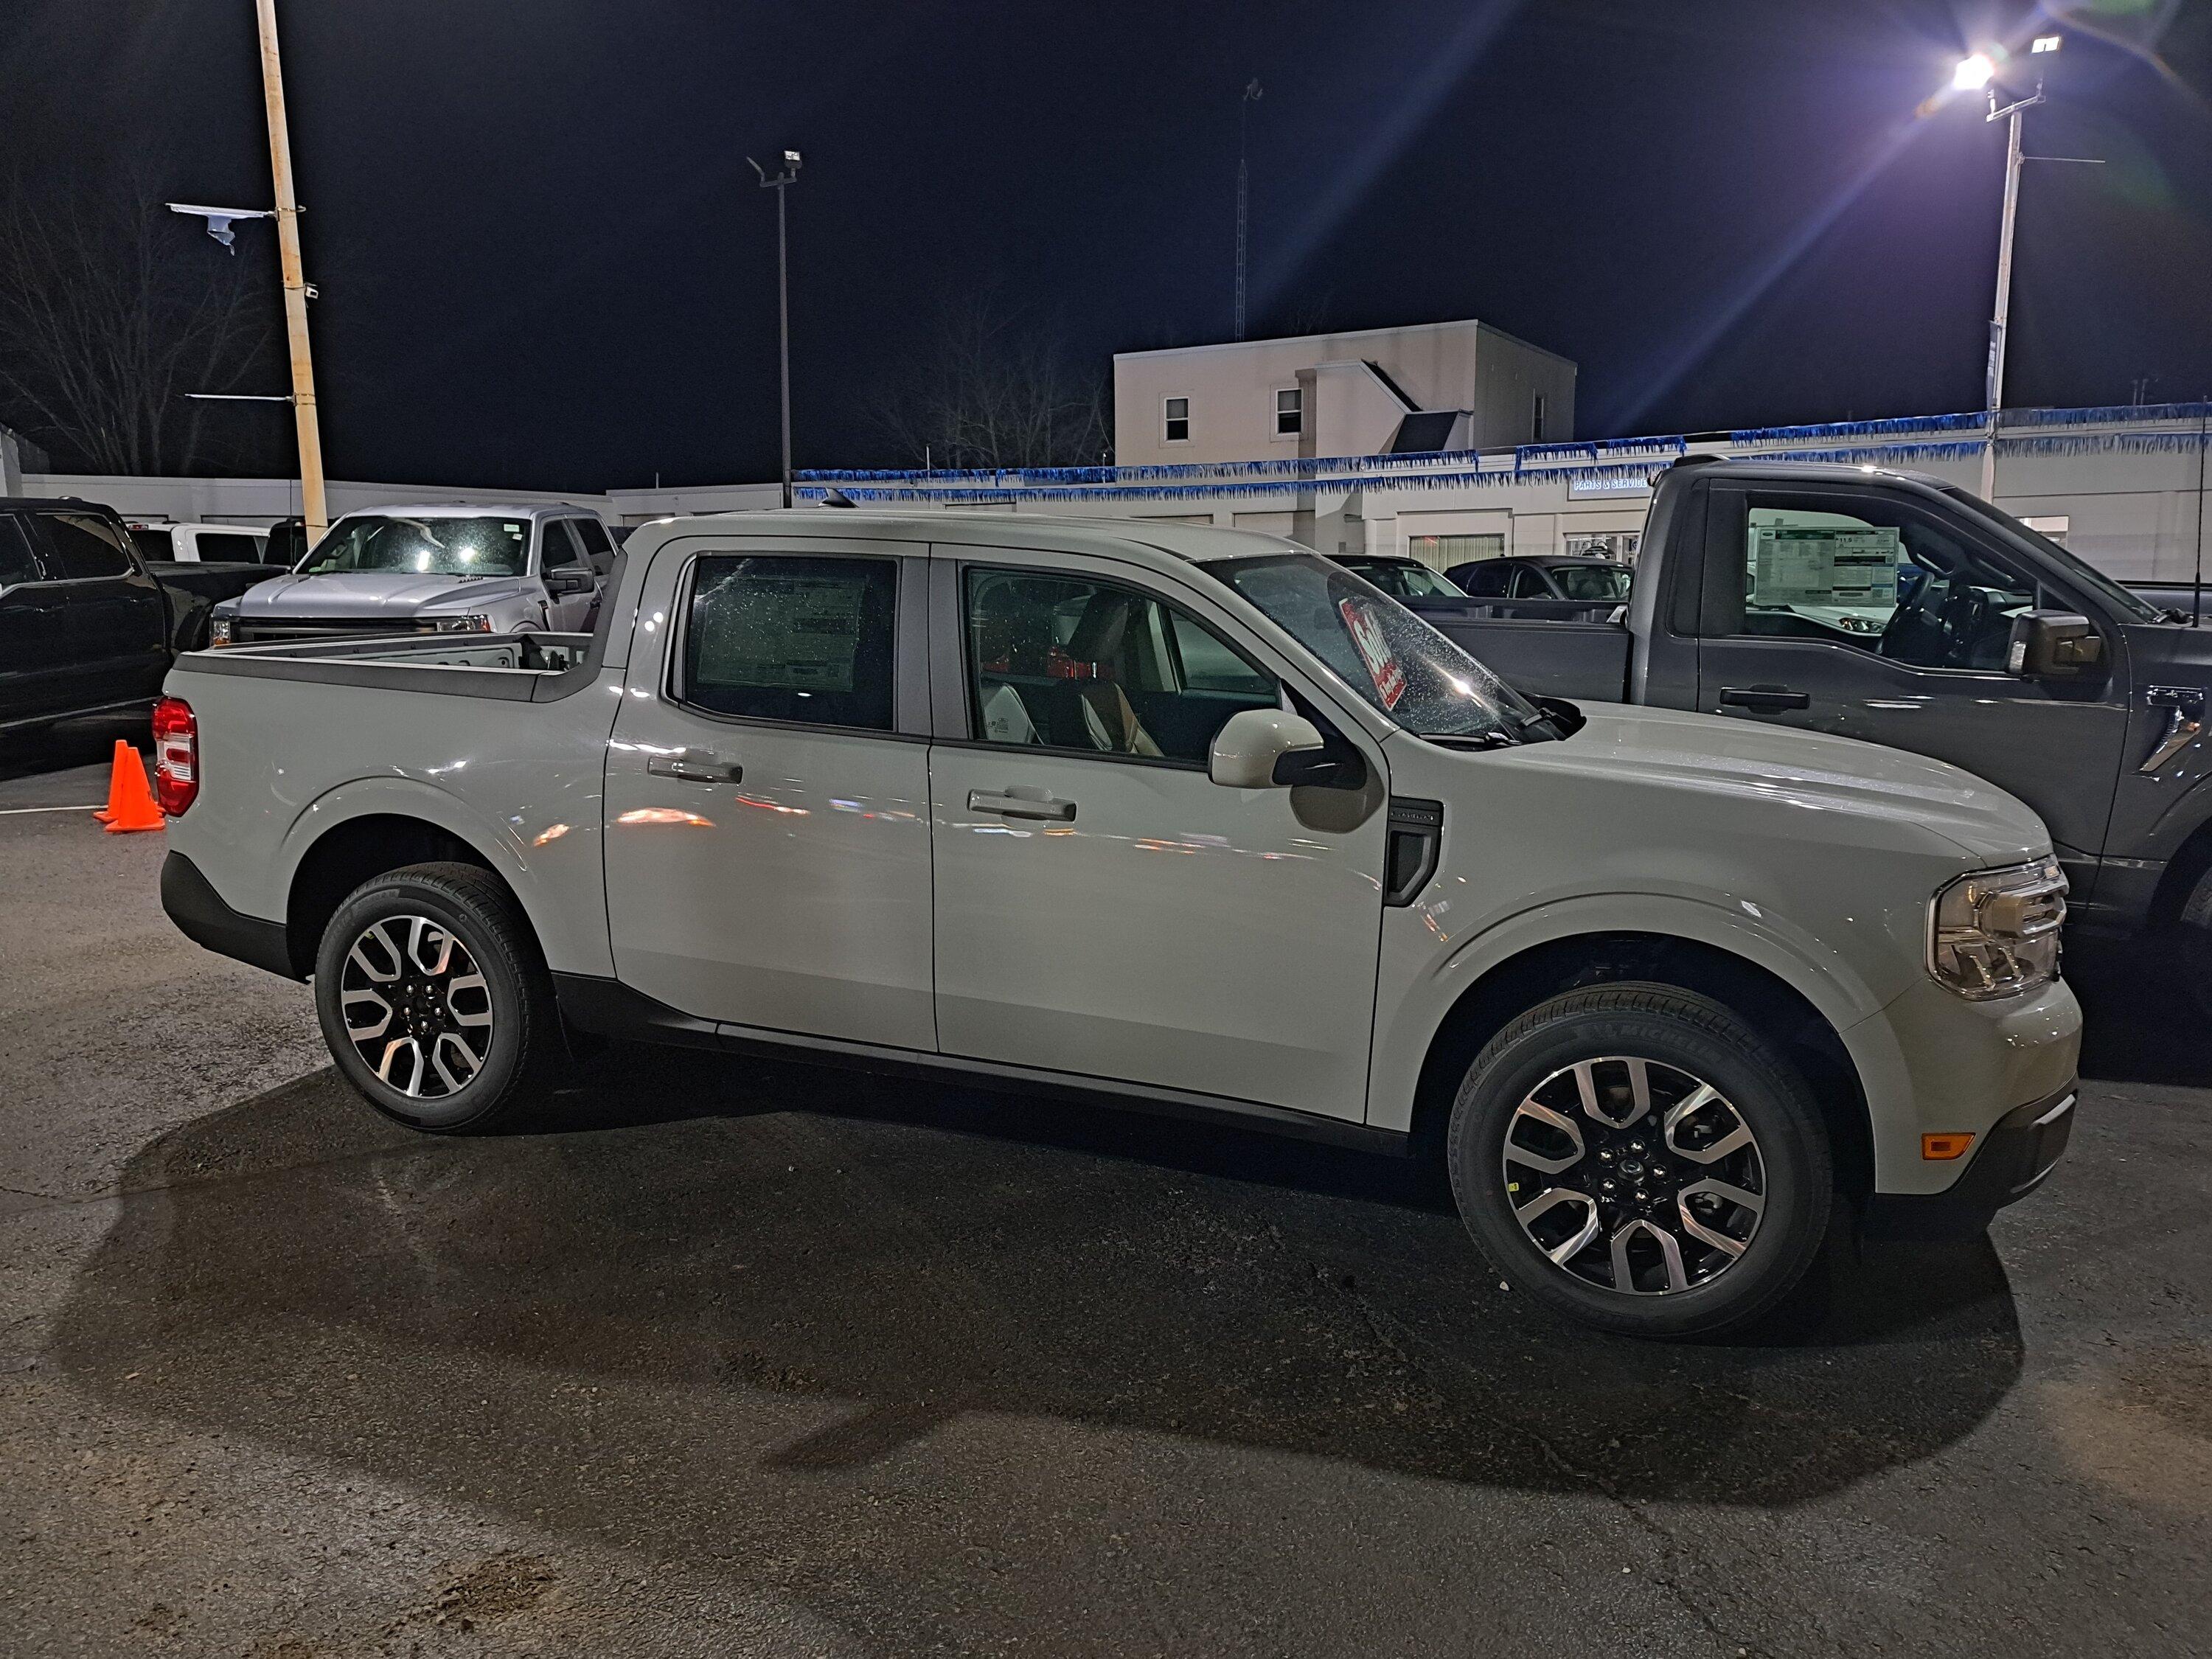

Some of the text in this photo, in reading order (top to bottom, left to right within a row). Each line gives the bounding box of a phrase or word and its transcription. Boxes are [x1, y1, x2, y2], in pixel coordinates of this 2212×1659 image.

[1574, 477, 1648, 490] PARTS & SERVICE
[1353, 611, 1392, 675] Sold
